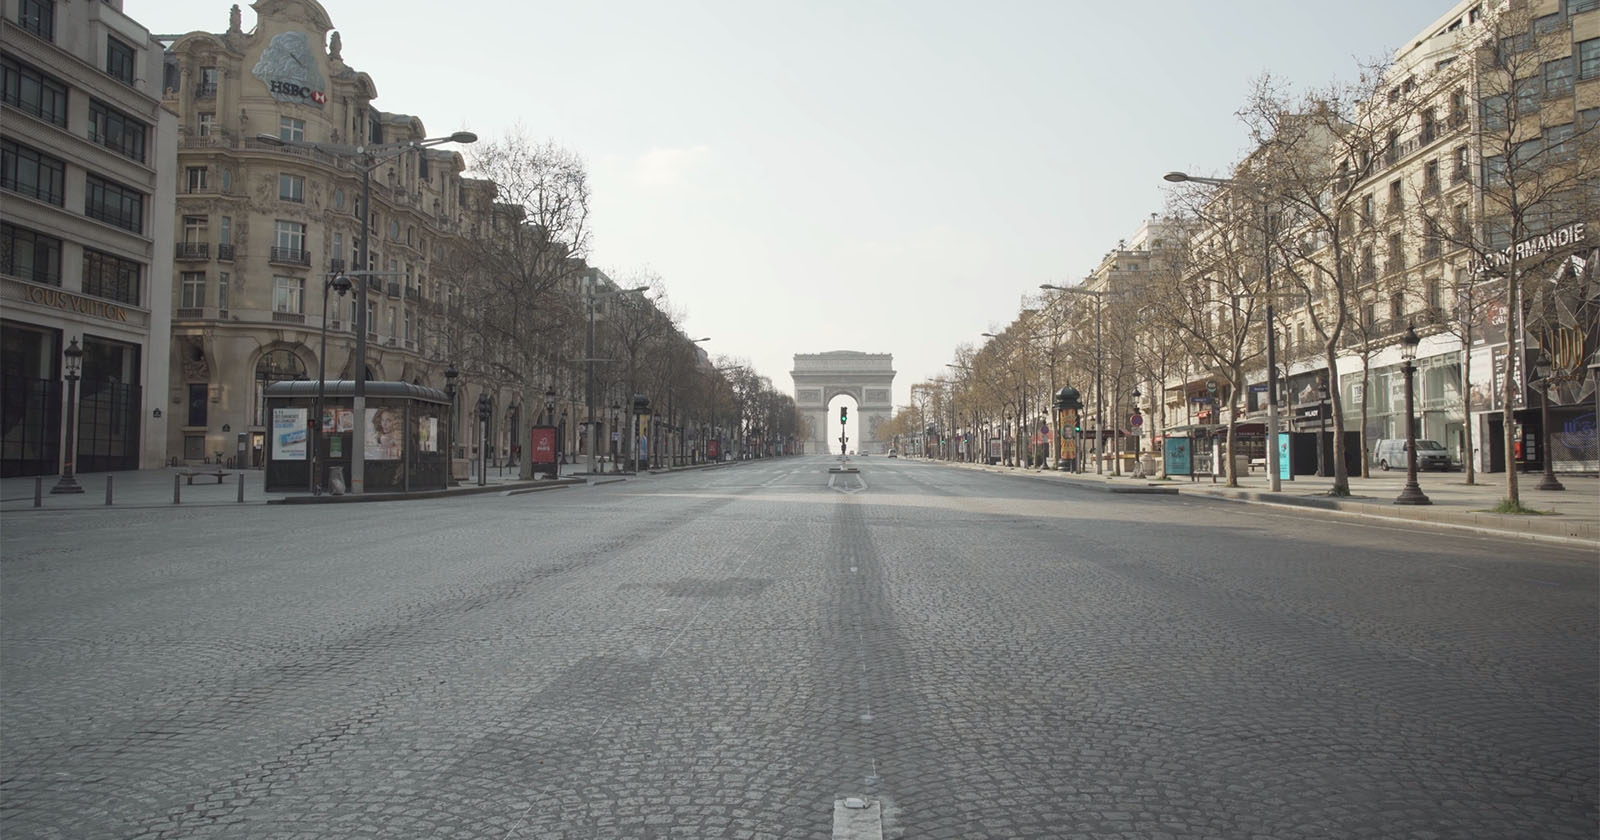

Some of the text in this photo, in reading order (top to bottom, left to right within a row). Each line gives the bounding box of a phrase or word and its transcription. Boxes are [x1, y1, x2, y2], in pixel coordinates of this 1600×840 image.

[270, 80, 311, 98] HSBC
[1496, 222, 1585, 267] NORMANDIE
[24, 286, 128, 321] LOUIS VUITTON
